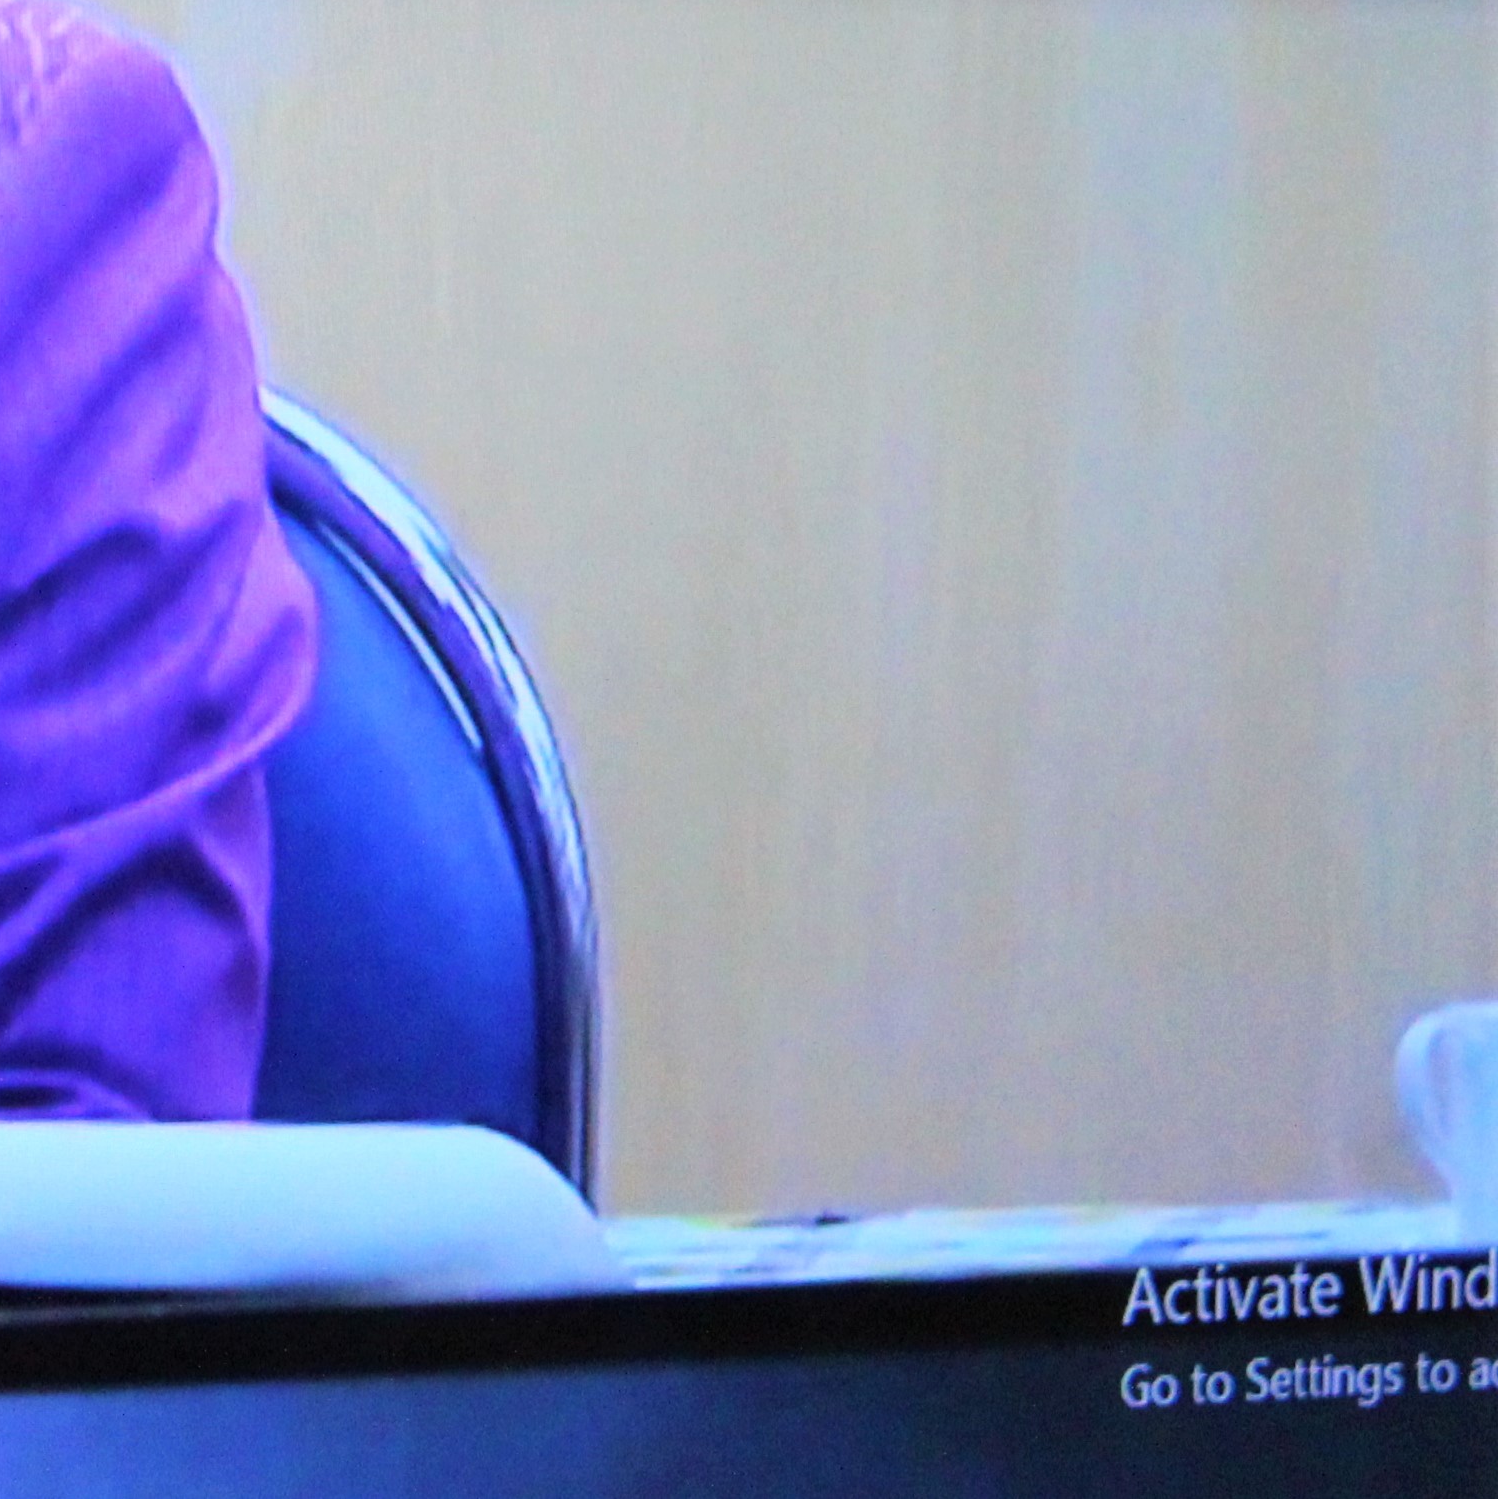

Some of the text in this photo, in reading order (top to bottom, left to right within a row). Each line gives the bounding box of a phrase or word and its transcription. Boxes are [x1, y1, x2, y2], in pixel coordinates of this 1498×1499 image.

[1121, 1261, 1344, 1327] Activate
[1120, 1362, 1181, 1409] Go
[1191, 1363, 1238, 1405] to
[1245, 1353, 1405, 1409] Settings
[1416, 1351, 1460, 1394] to
